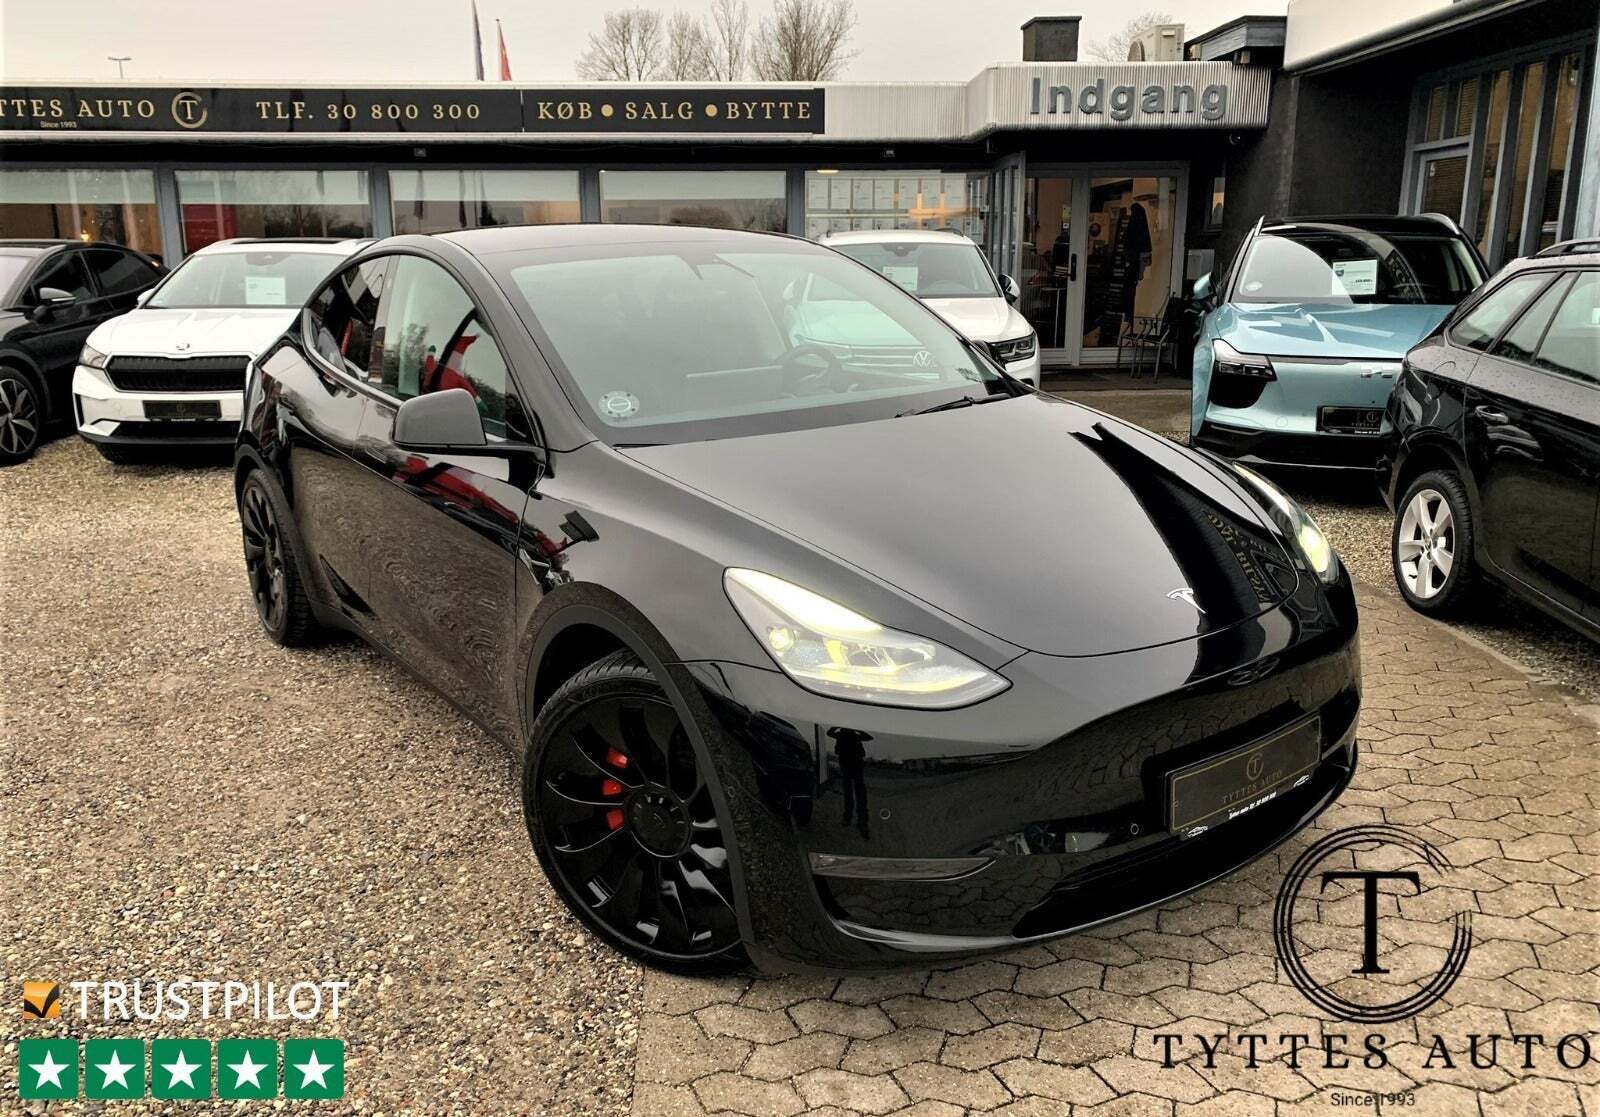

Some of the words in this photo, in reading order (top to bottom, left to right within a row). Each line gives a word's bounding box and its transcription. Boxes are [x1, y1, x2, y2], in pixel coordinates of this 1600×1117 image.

[78, 99, 154, 117] AUTO
[1030, 77, 1228, 121] Indgang
[256, 101, 314, 119] TLF.
[328, 104, 357, 120] 30
[371, 104, 418, 120] 800
[433, 104, 480, 119] 300
[537, 102, 592, 119] KØB
[625, 102, 694, 119] SALG
[726, 102, 810, 119] BYTTE
